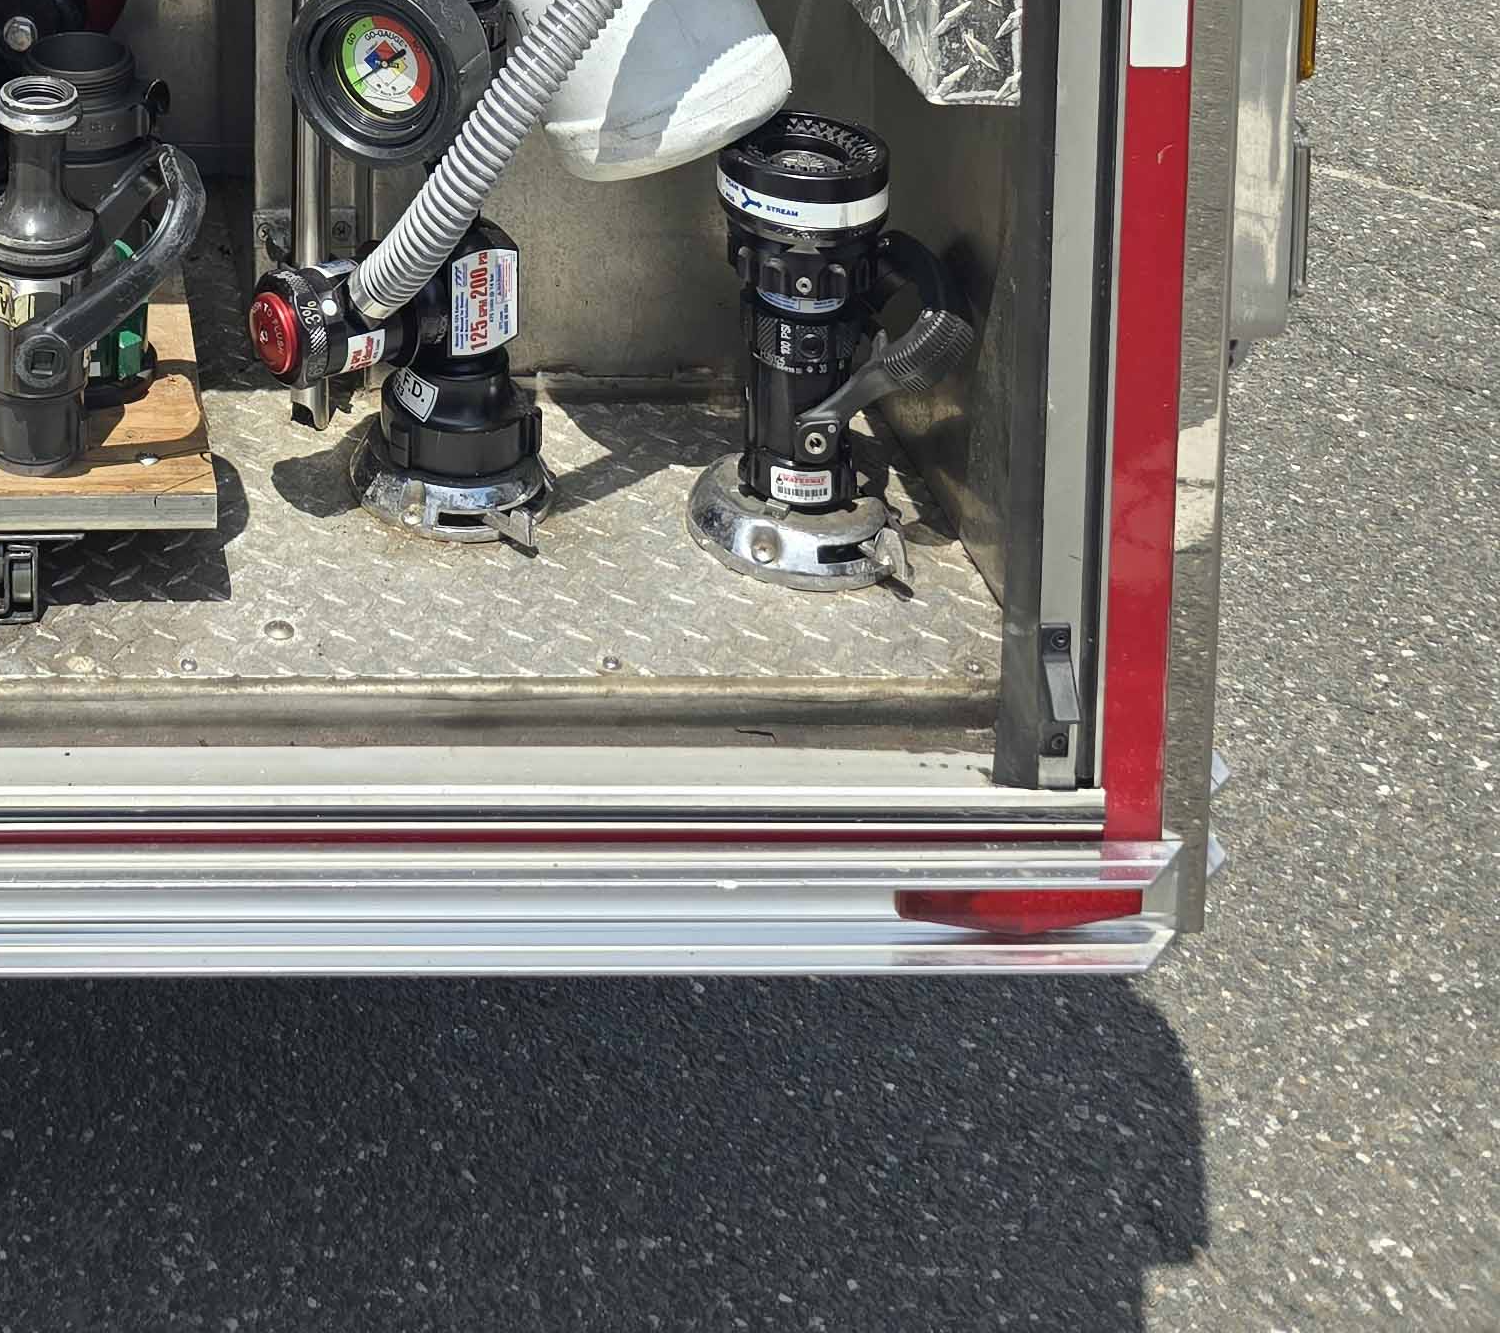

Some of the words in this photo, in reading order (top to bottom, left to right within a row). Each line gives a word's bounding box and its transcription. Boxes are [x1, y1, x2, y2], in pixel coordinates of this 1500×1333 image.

[346, 32, 357, 46] GO
[766, 205, 798, 217] STREAM
[479, 252, 488, 265] PSI
[470, 267, 488, 300] 200
[263, 302, 273, 317] TO
[299, 300, 322, 325] 3%
[479, 299, 488, 318] GPM
[470, 319, 488, 351] 125
[780, 323, 792, 339] PSI
[403, 371, 425, 403] F.D.
